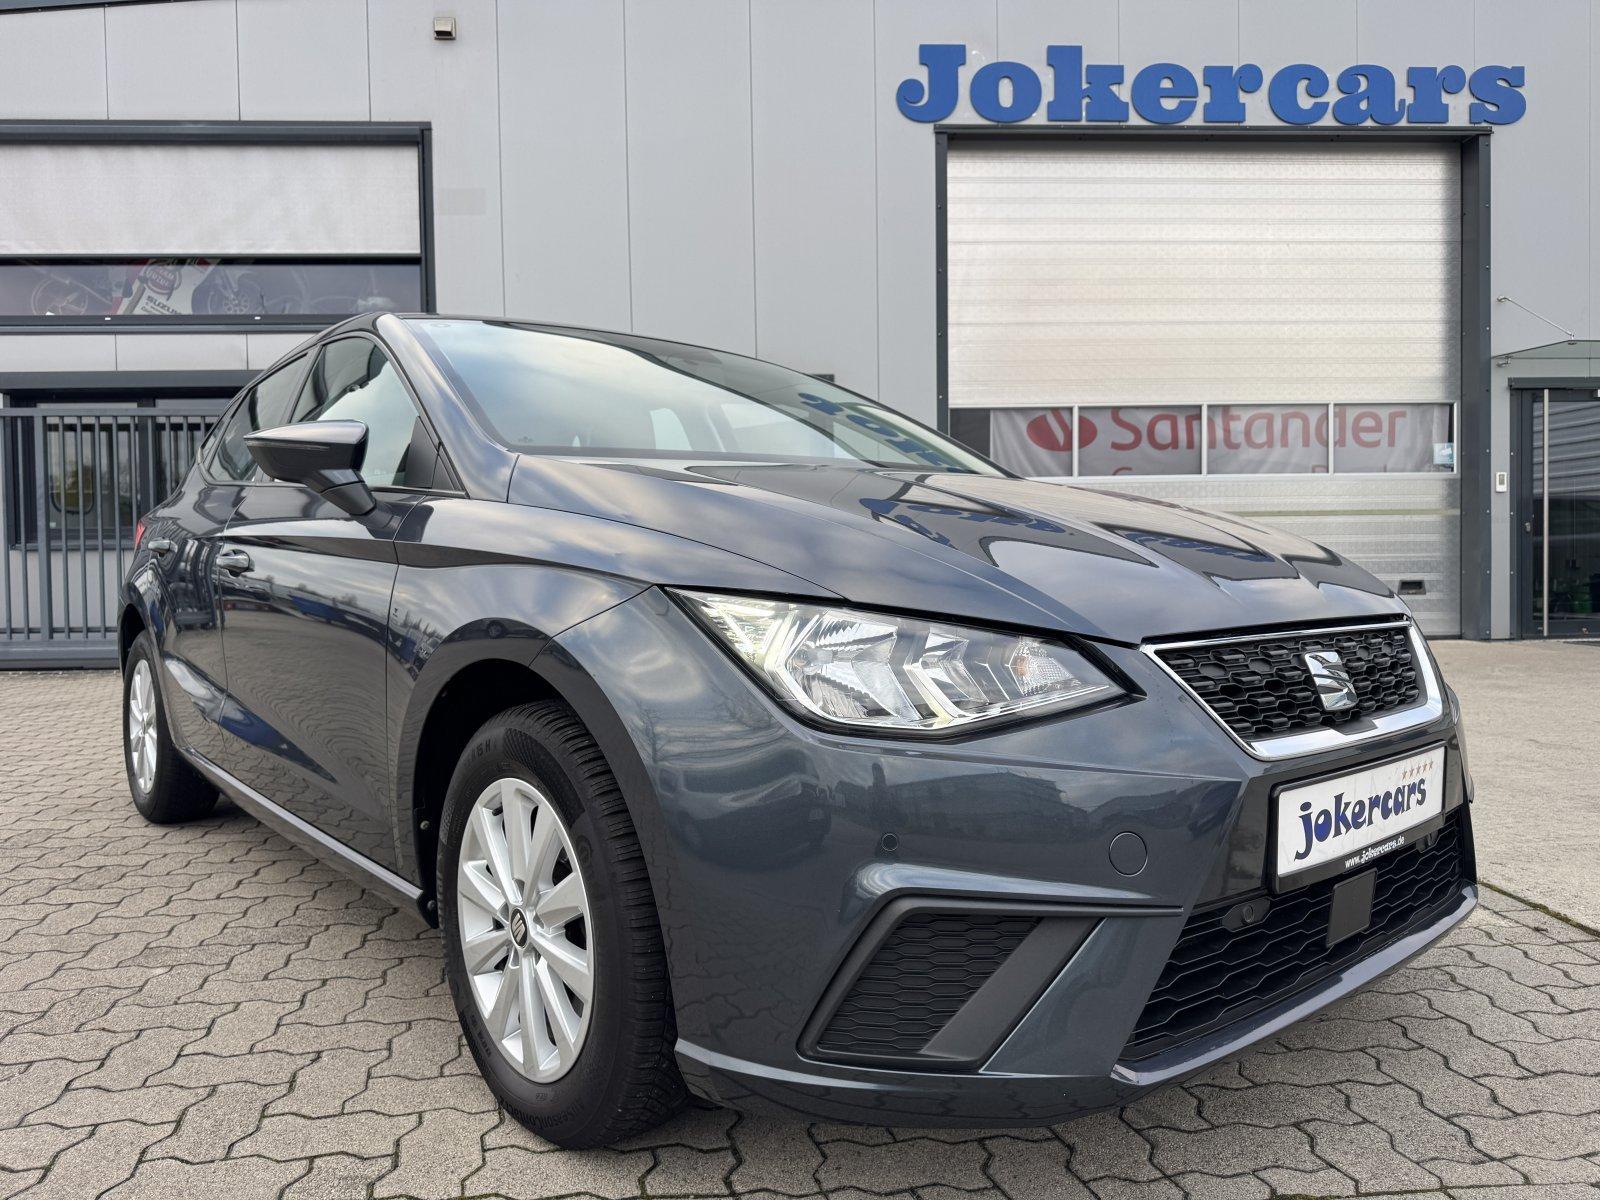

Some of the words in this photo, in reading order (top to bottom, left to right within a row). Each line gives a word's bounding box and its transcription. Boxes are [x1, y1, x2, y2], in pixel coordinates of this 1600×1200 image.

[896, 44, 1526, 125] Jokercars
[1110, 403, 1406, 450] Santander
[1294, 778, 1427, 861] jokercars
[1345, 835, 1404, 868] www.jokercars.de
